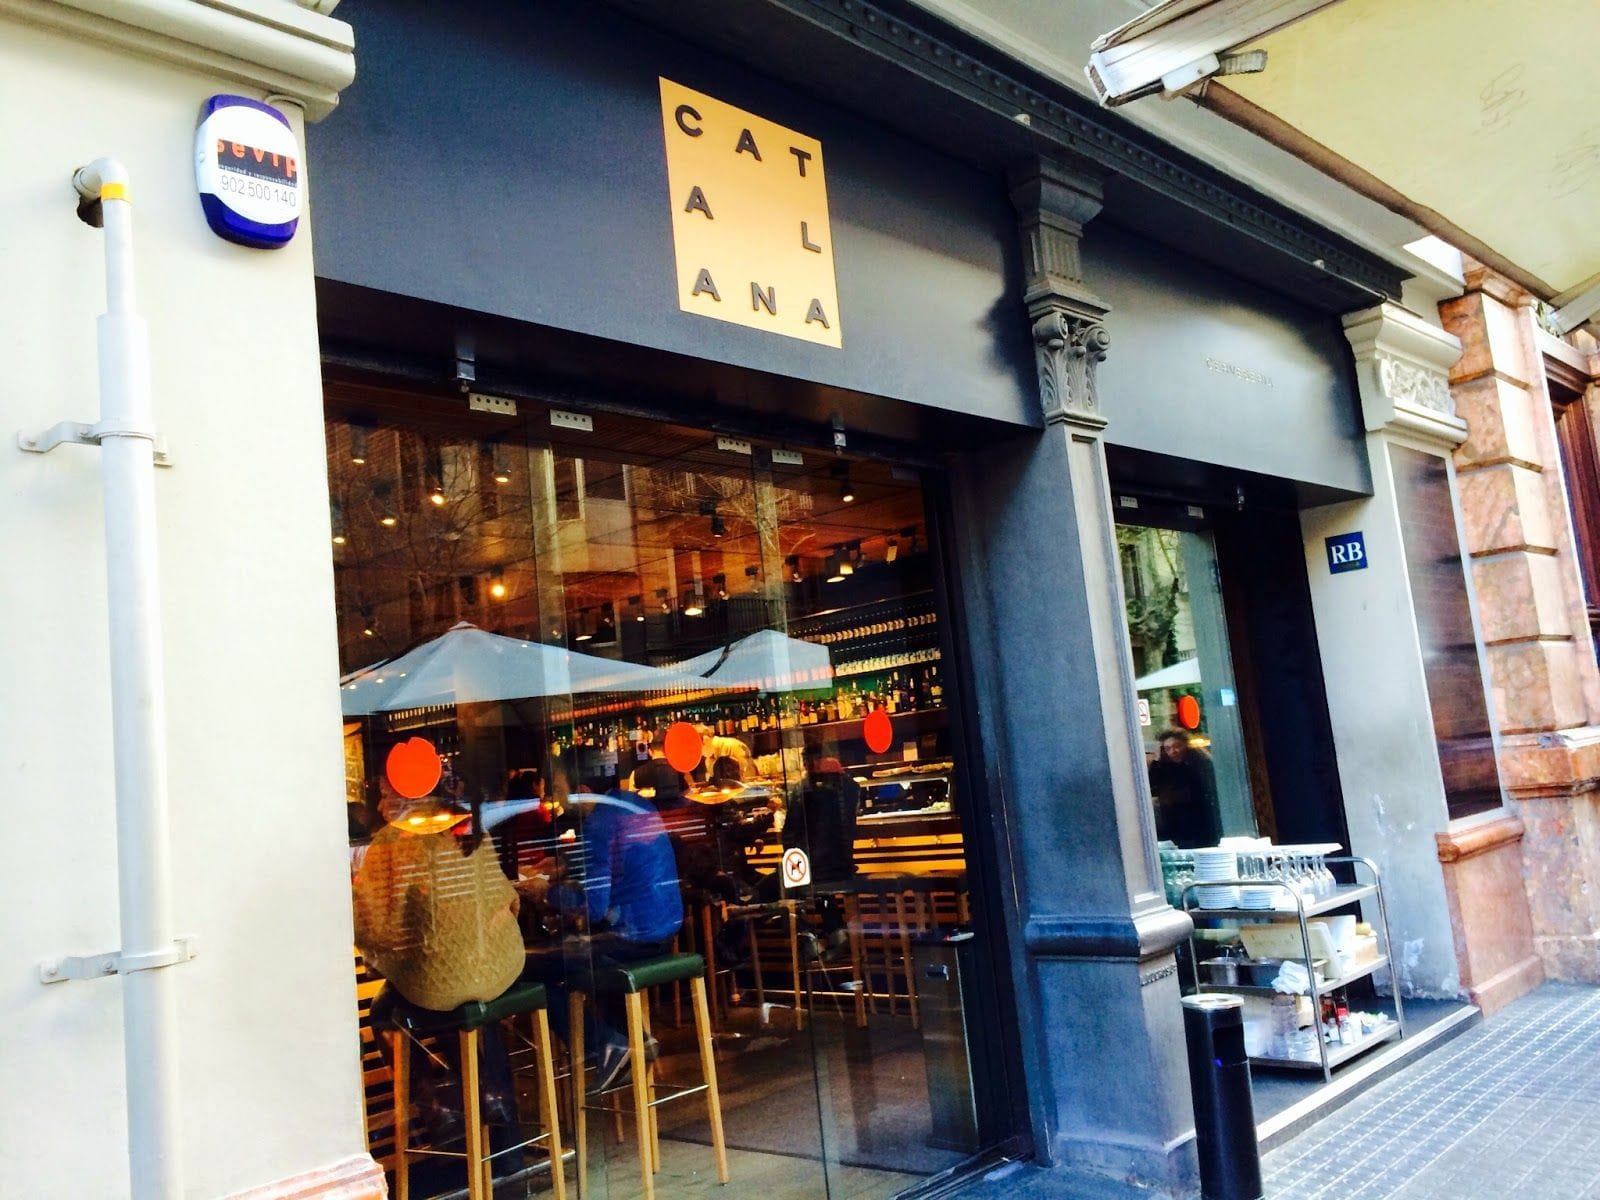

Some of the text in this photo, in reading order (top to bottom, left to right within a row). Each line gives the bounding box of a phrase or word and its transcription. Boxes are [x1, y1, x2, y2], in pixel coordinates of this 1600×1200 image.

[221, 174, 297, 207] 902 500 140
[1331, 541, 1364, 564] RB
